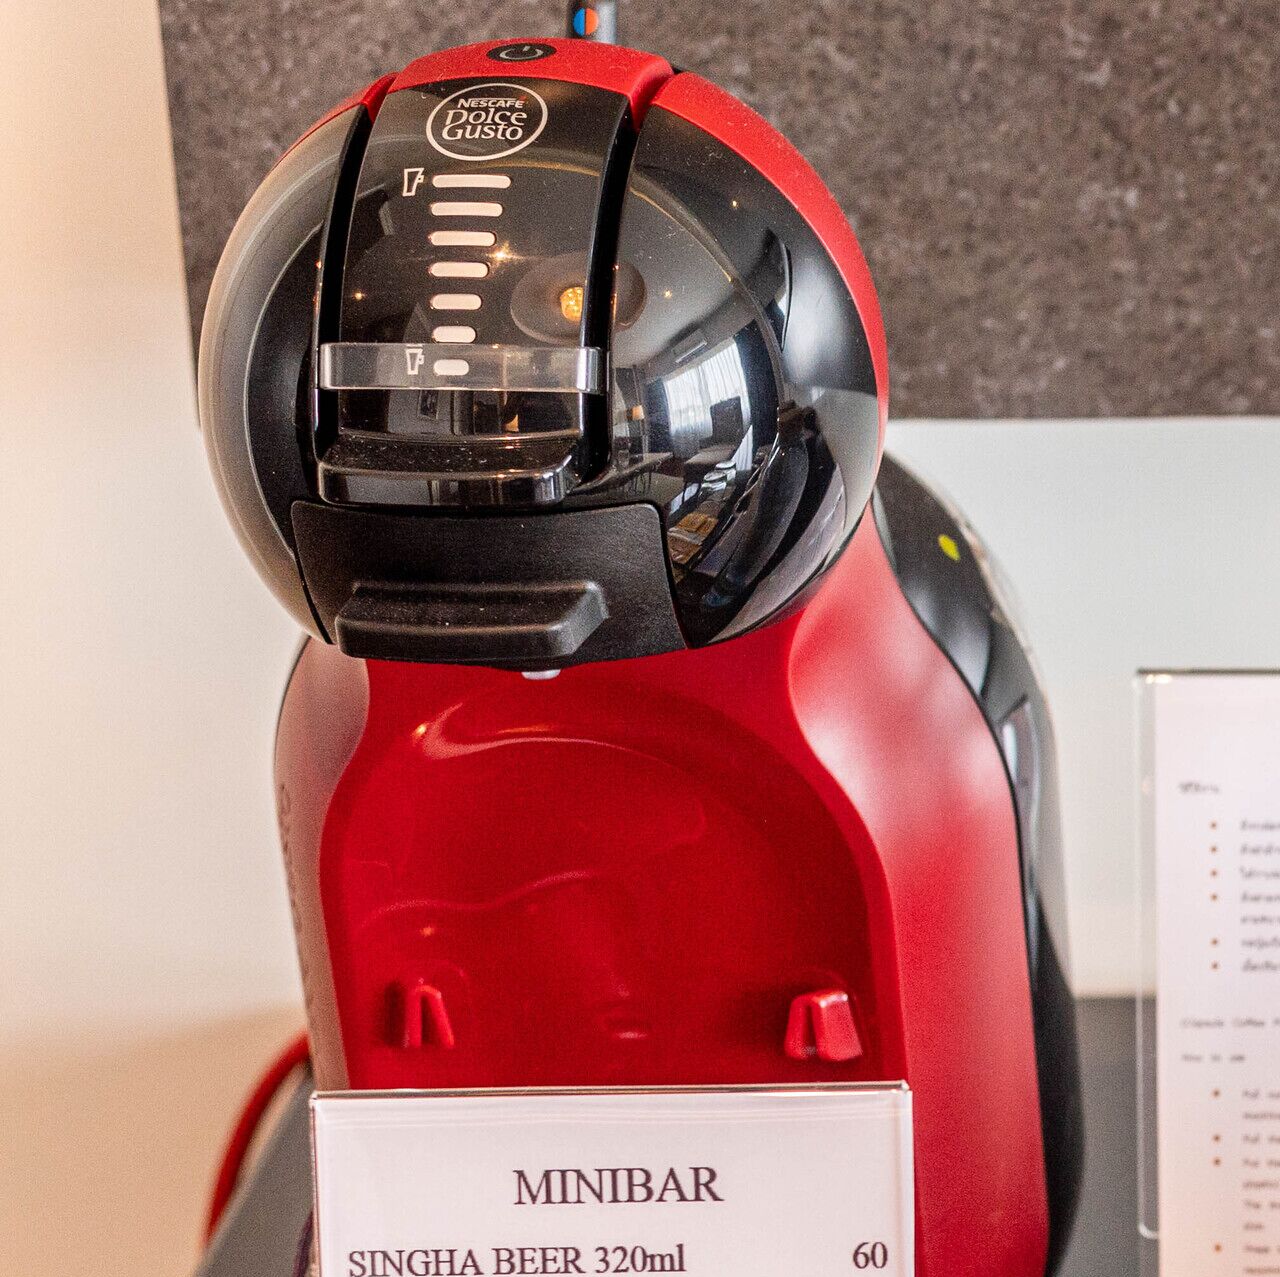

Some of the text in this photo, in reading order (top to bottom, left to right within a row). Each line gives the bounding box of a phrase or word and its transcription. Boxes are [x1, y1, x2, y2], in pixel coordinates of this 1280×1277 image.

[445, 108, 528, 126] Dolce
[442, 123, 523, 140] Gusto
[513, 1167, 724, 1205] MINIBAR
[348, 1241, 889, 1277] SINGHA BEER 320ml 60
